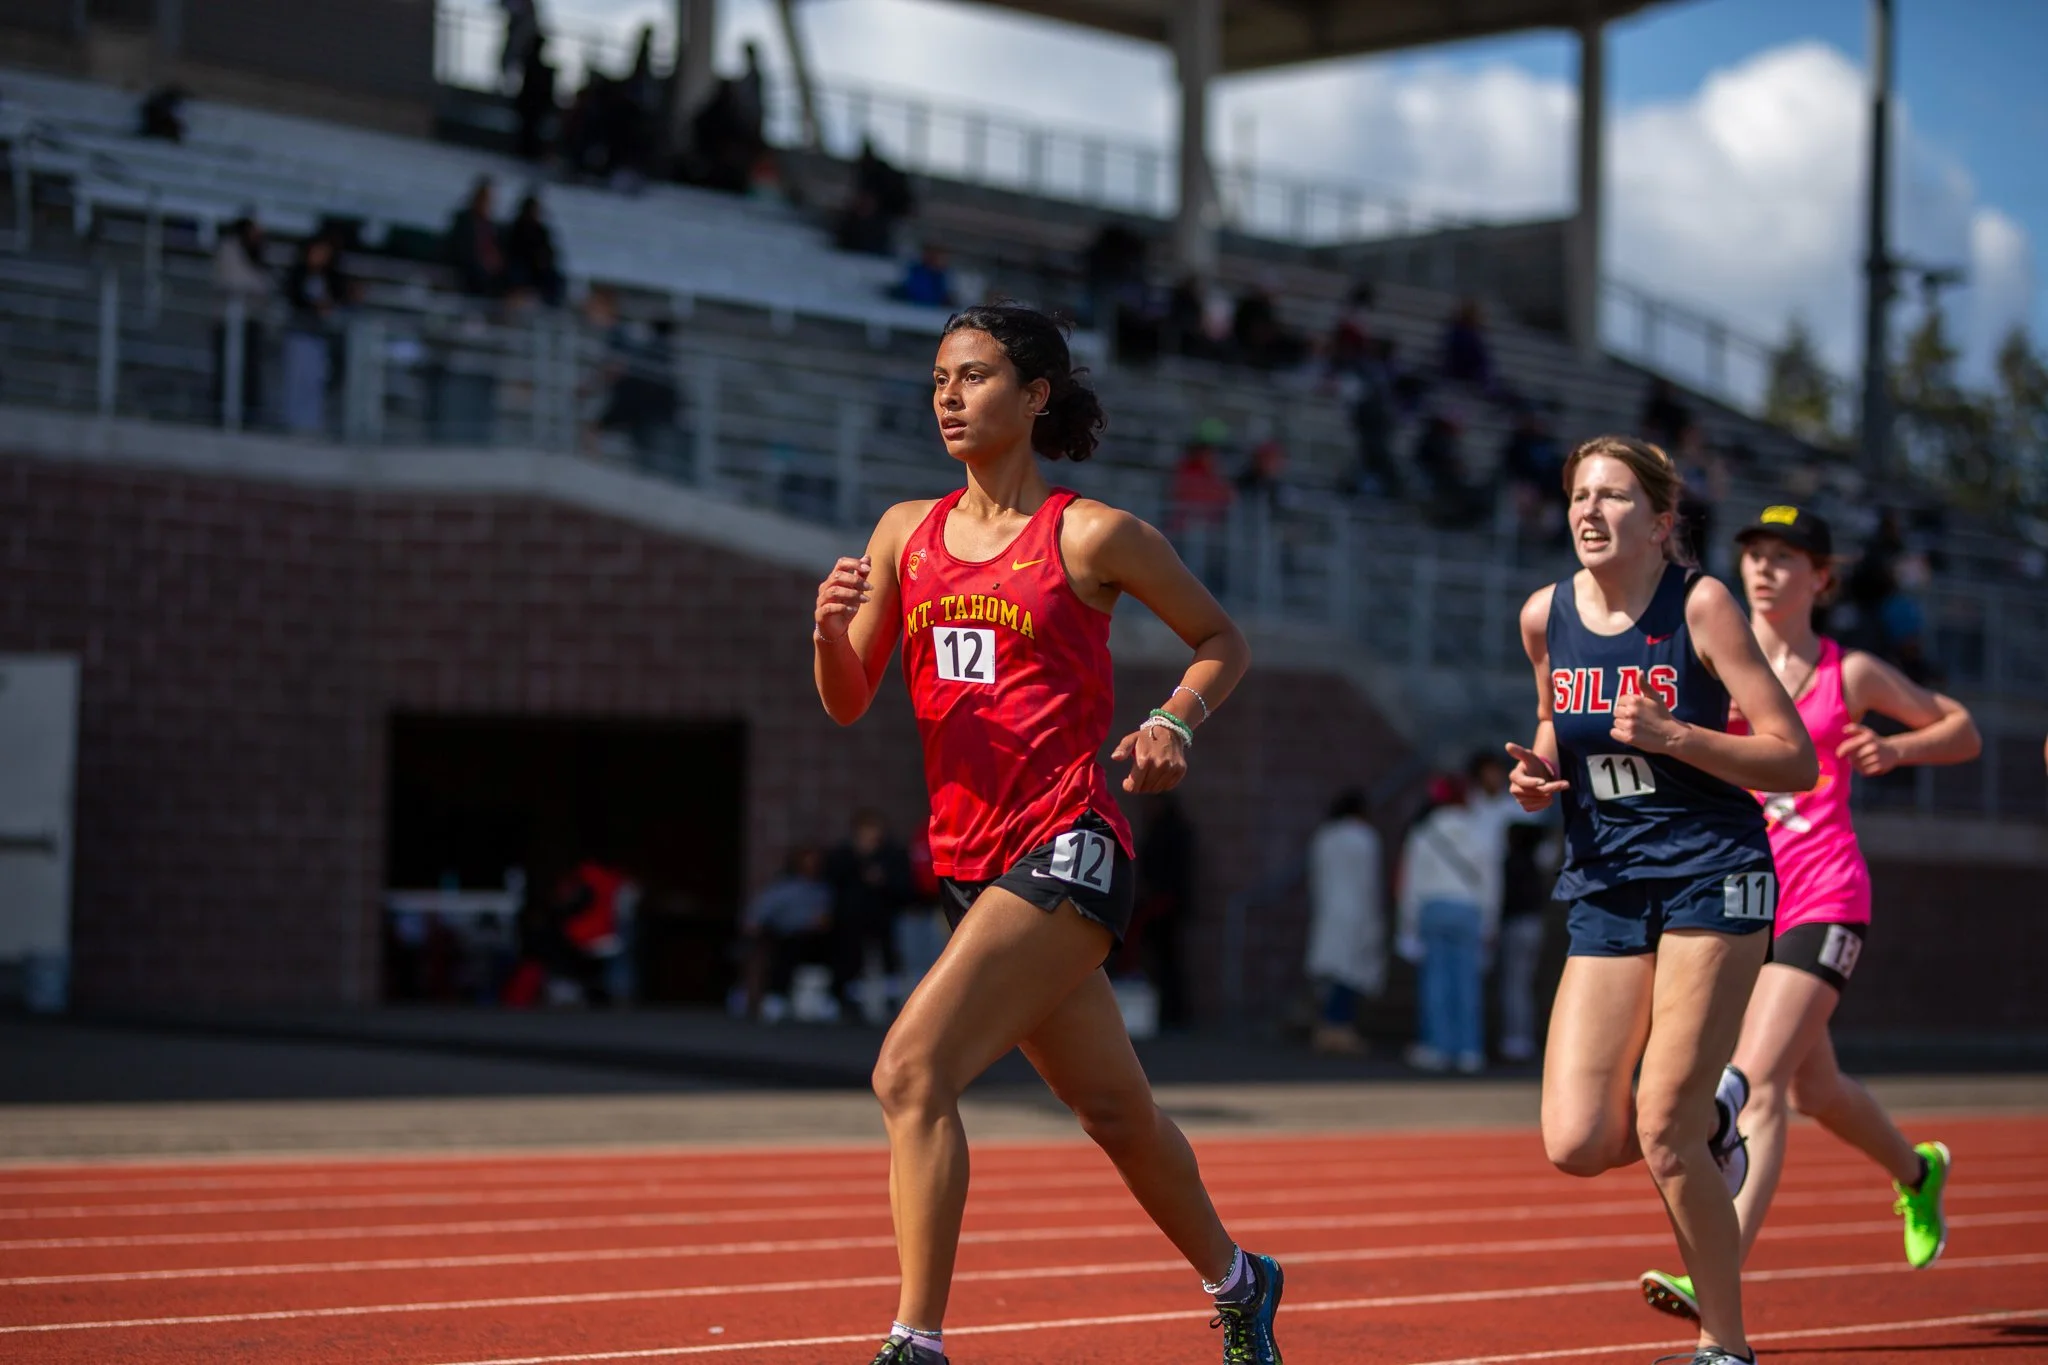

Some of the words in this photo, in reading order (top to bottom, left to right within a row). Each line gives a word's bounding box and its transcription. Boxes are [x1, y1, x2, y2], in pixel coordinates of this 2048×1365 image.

[907, 600, 936, 639] MT.
[940, 594, 1035, 640] TAHOMA
[943, 630, 984, 680] 12
[1552, 665, 1678, 714] SILAS
[1601, 757, 1641, 795] 11
[1068, 832, 1106, 886] 12
[1735, 875, 1766, 916] 11
